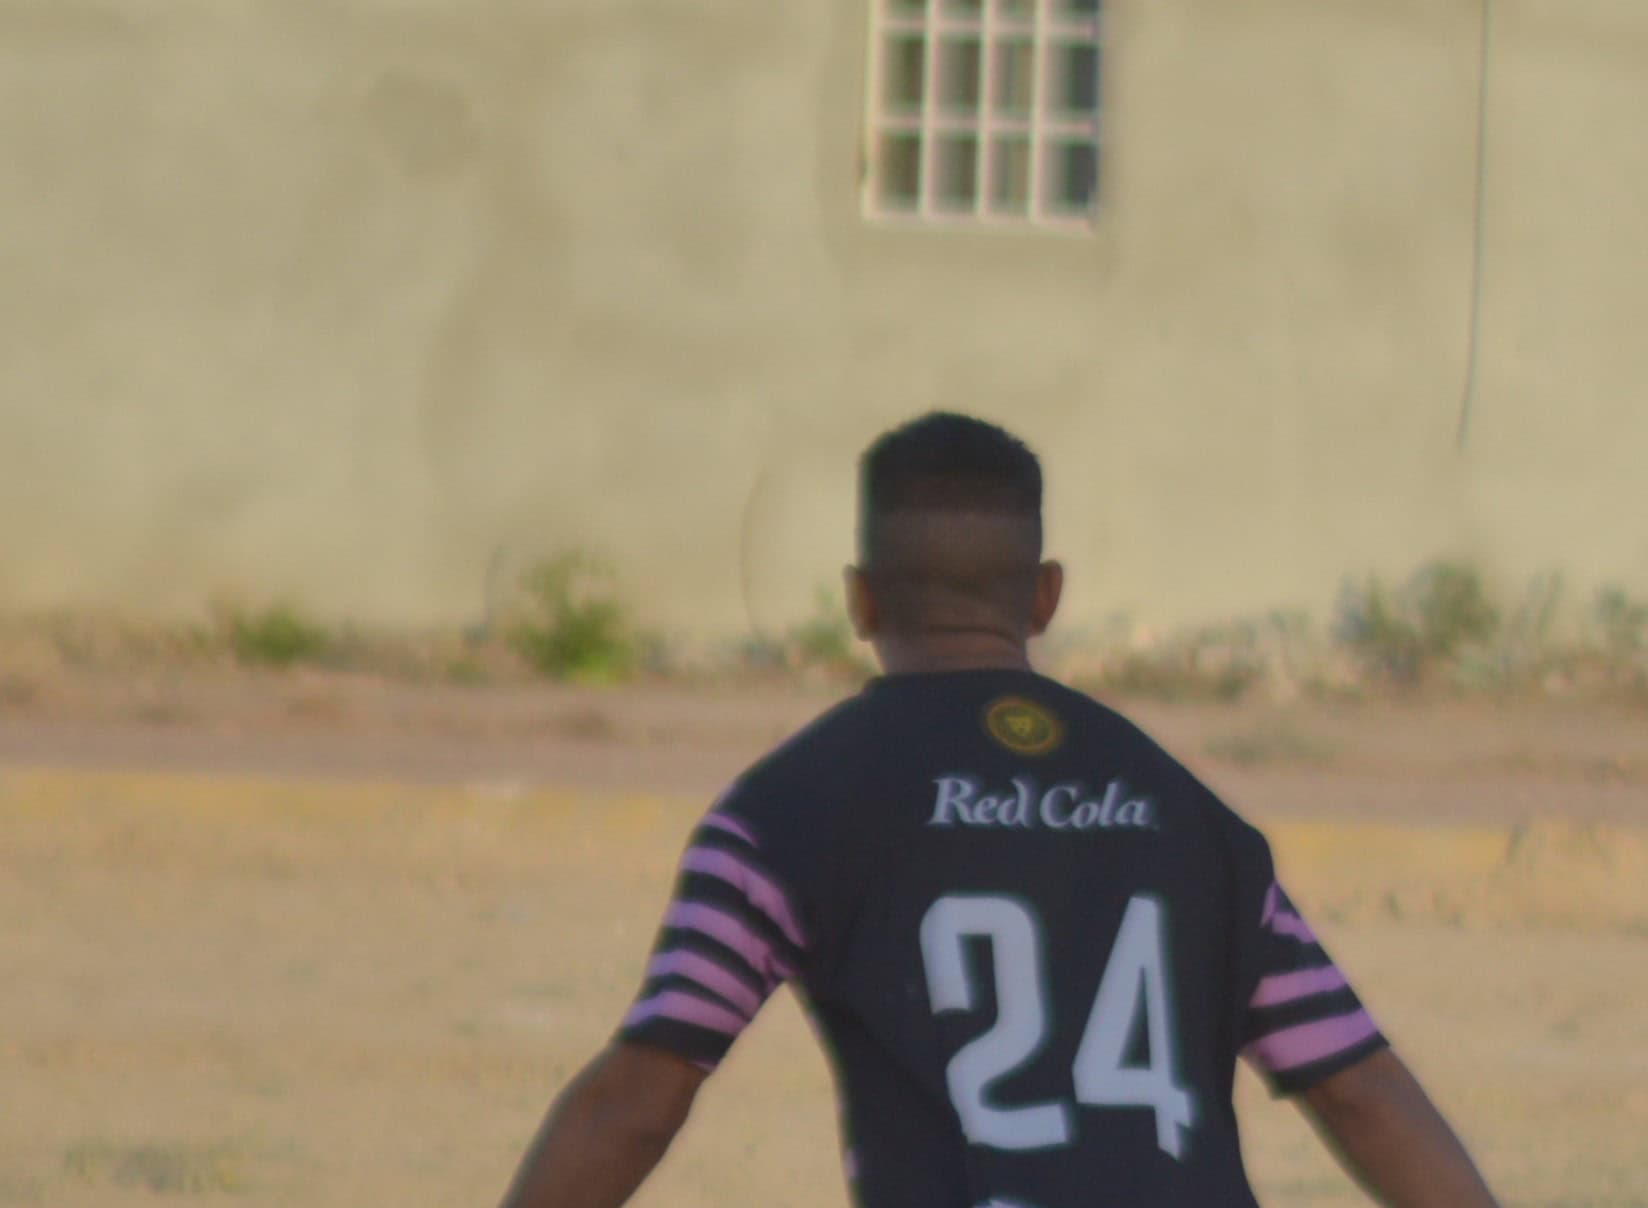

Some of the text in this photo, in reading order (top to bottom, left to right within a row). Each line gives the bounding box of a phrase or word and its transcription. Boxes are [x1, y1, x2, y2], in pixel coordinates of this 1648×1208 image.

[928, 776, 1153, 829] Red Cola
[919, 895, 1195, 1161] 24
